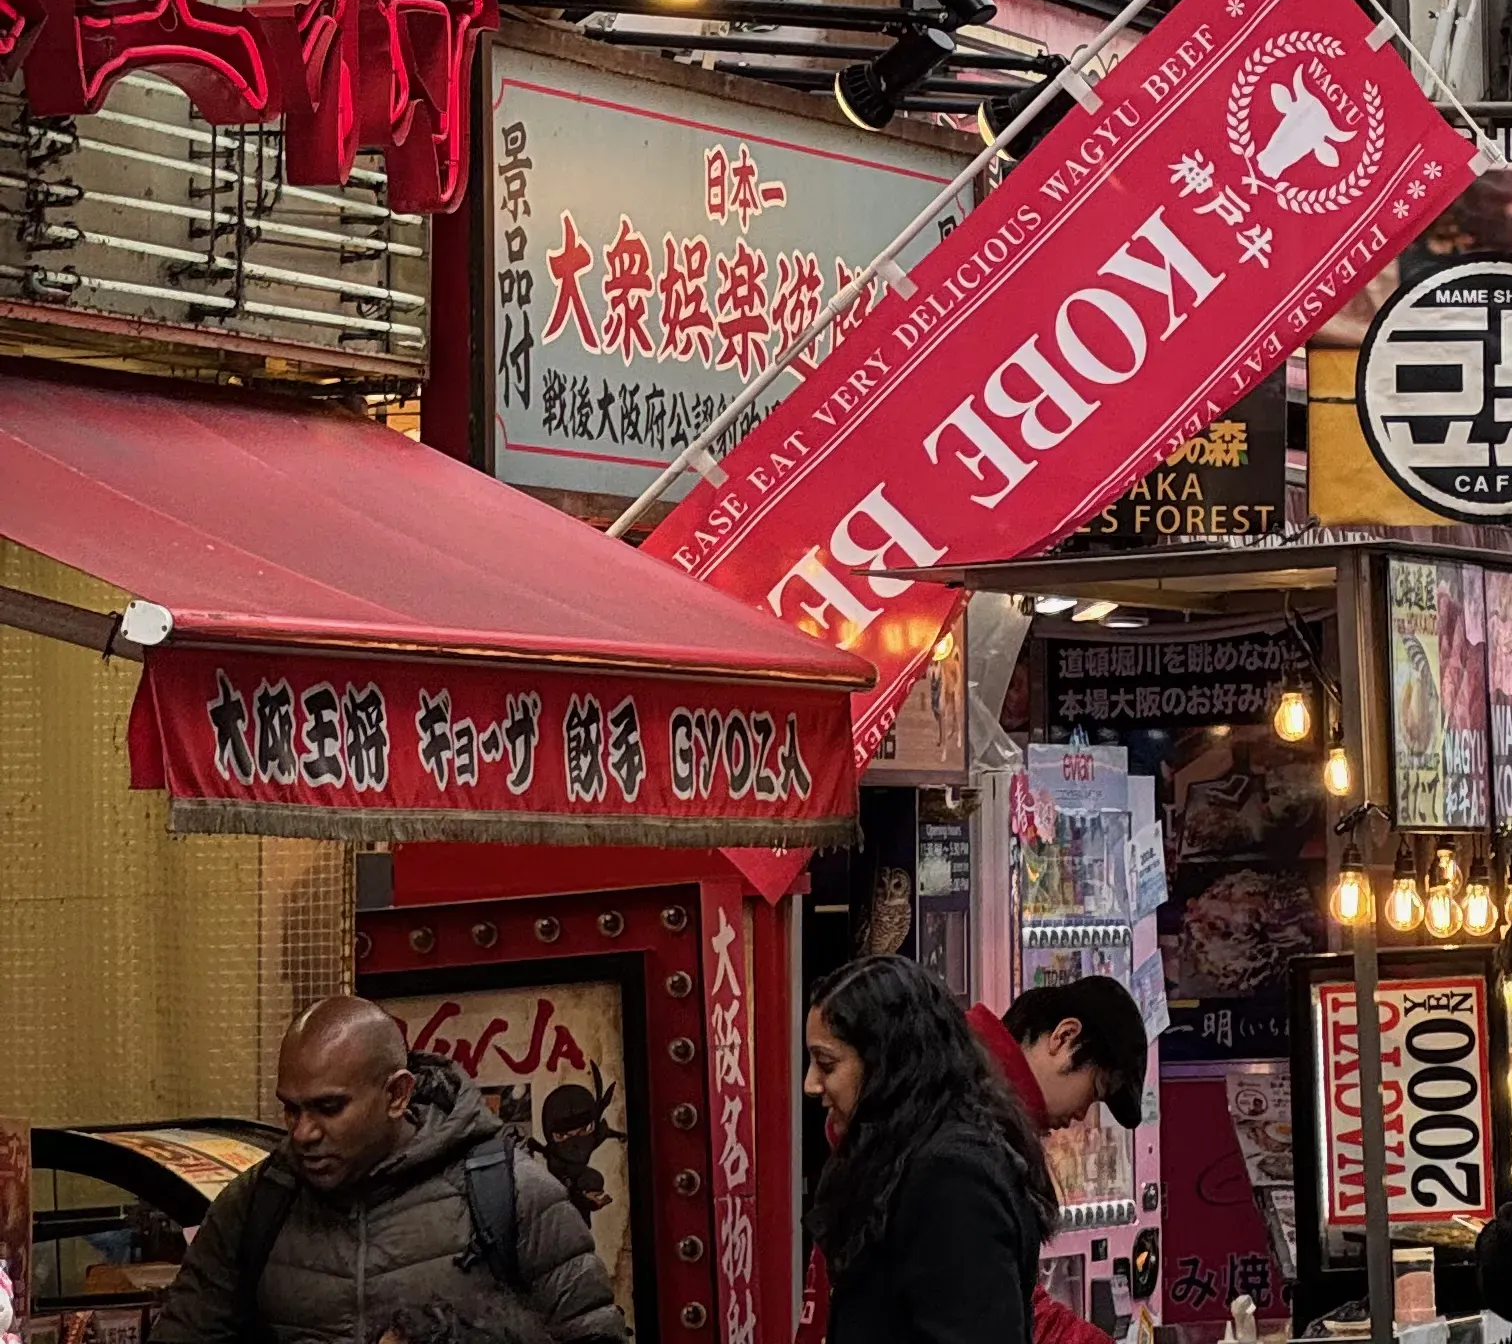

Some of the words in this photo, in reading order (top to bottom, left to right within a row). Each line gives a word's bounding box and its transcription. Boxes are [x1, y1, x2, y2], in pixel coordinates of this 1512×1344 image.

[1307, 56, 1365, 126] WAGYU
[705, 146, 786, 230] 日本一
[1168, 149, 1273, 270] 神戸牛
[747, 427, 816, 497] EAT
[812, 345, 898, 434] VERY
[891, 196, 1045, 357] DELICIOUS
[1040, 96, 1145, 206] WAGYU
[1140, 23, 1220, 105] BEEF
[1279, 221, 1391, 338] PLEASE
[1435, 289, 1488, 304] MAME
[923, 202, 1226, 512] KOBE
[1223, 330, 1286, 394] EAT
[1134, 505, 1275, 534] FOREST
[209, 668, 390, 794] 大阪王将
[418, 686, 541, 794] ギョーザ
[562, 692, 648, 804] 餃子
[669, 705, 814, 804] GYOZA
[1063, 752, 1096, 782] evian
[1444, 728, 1486, 775] WAGYU
[1403, 990, 1474, 1017] YEN
[1329, 996, 1409, 1217] WAGYU
[1405, 1017, 1482, 1209] 2000
